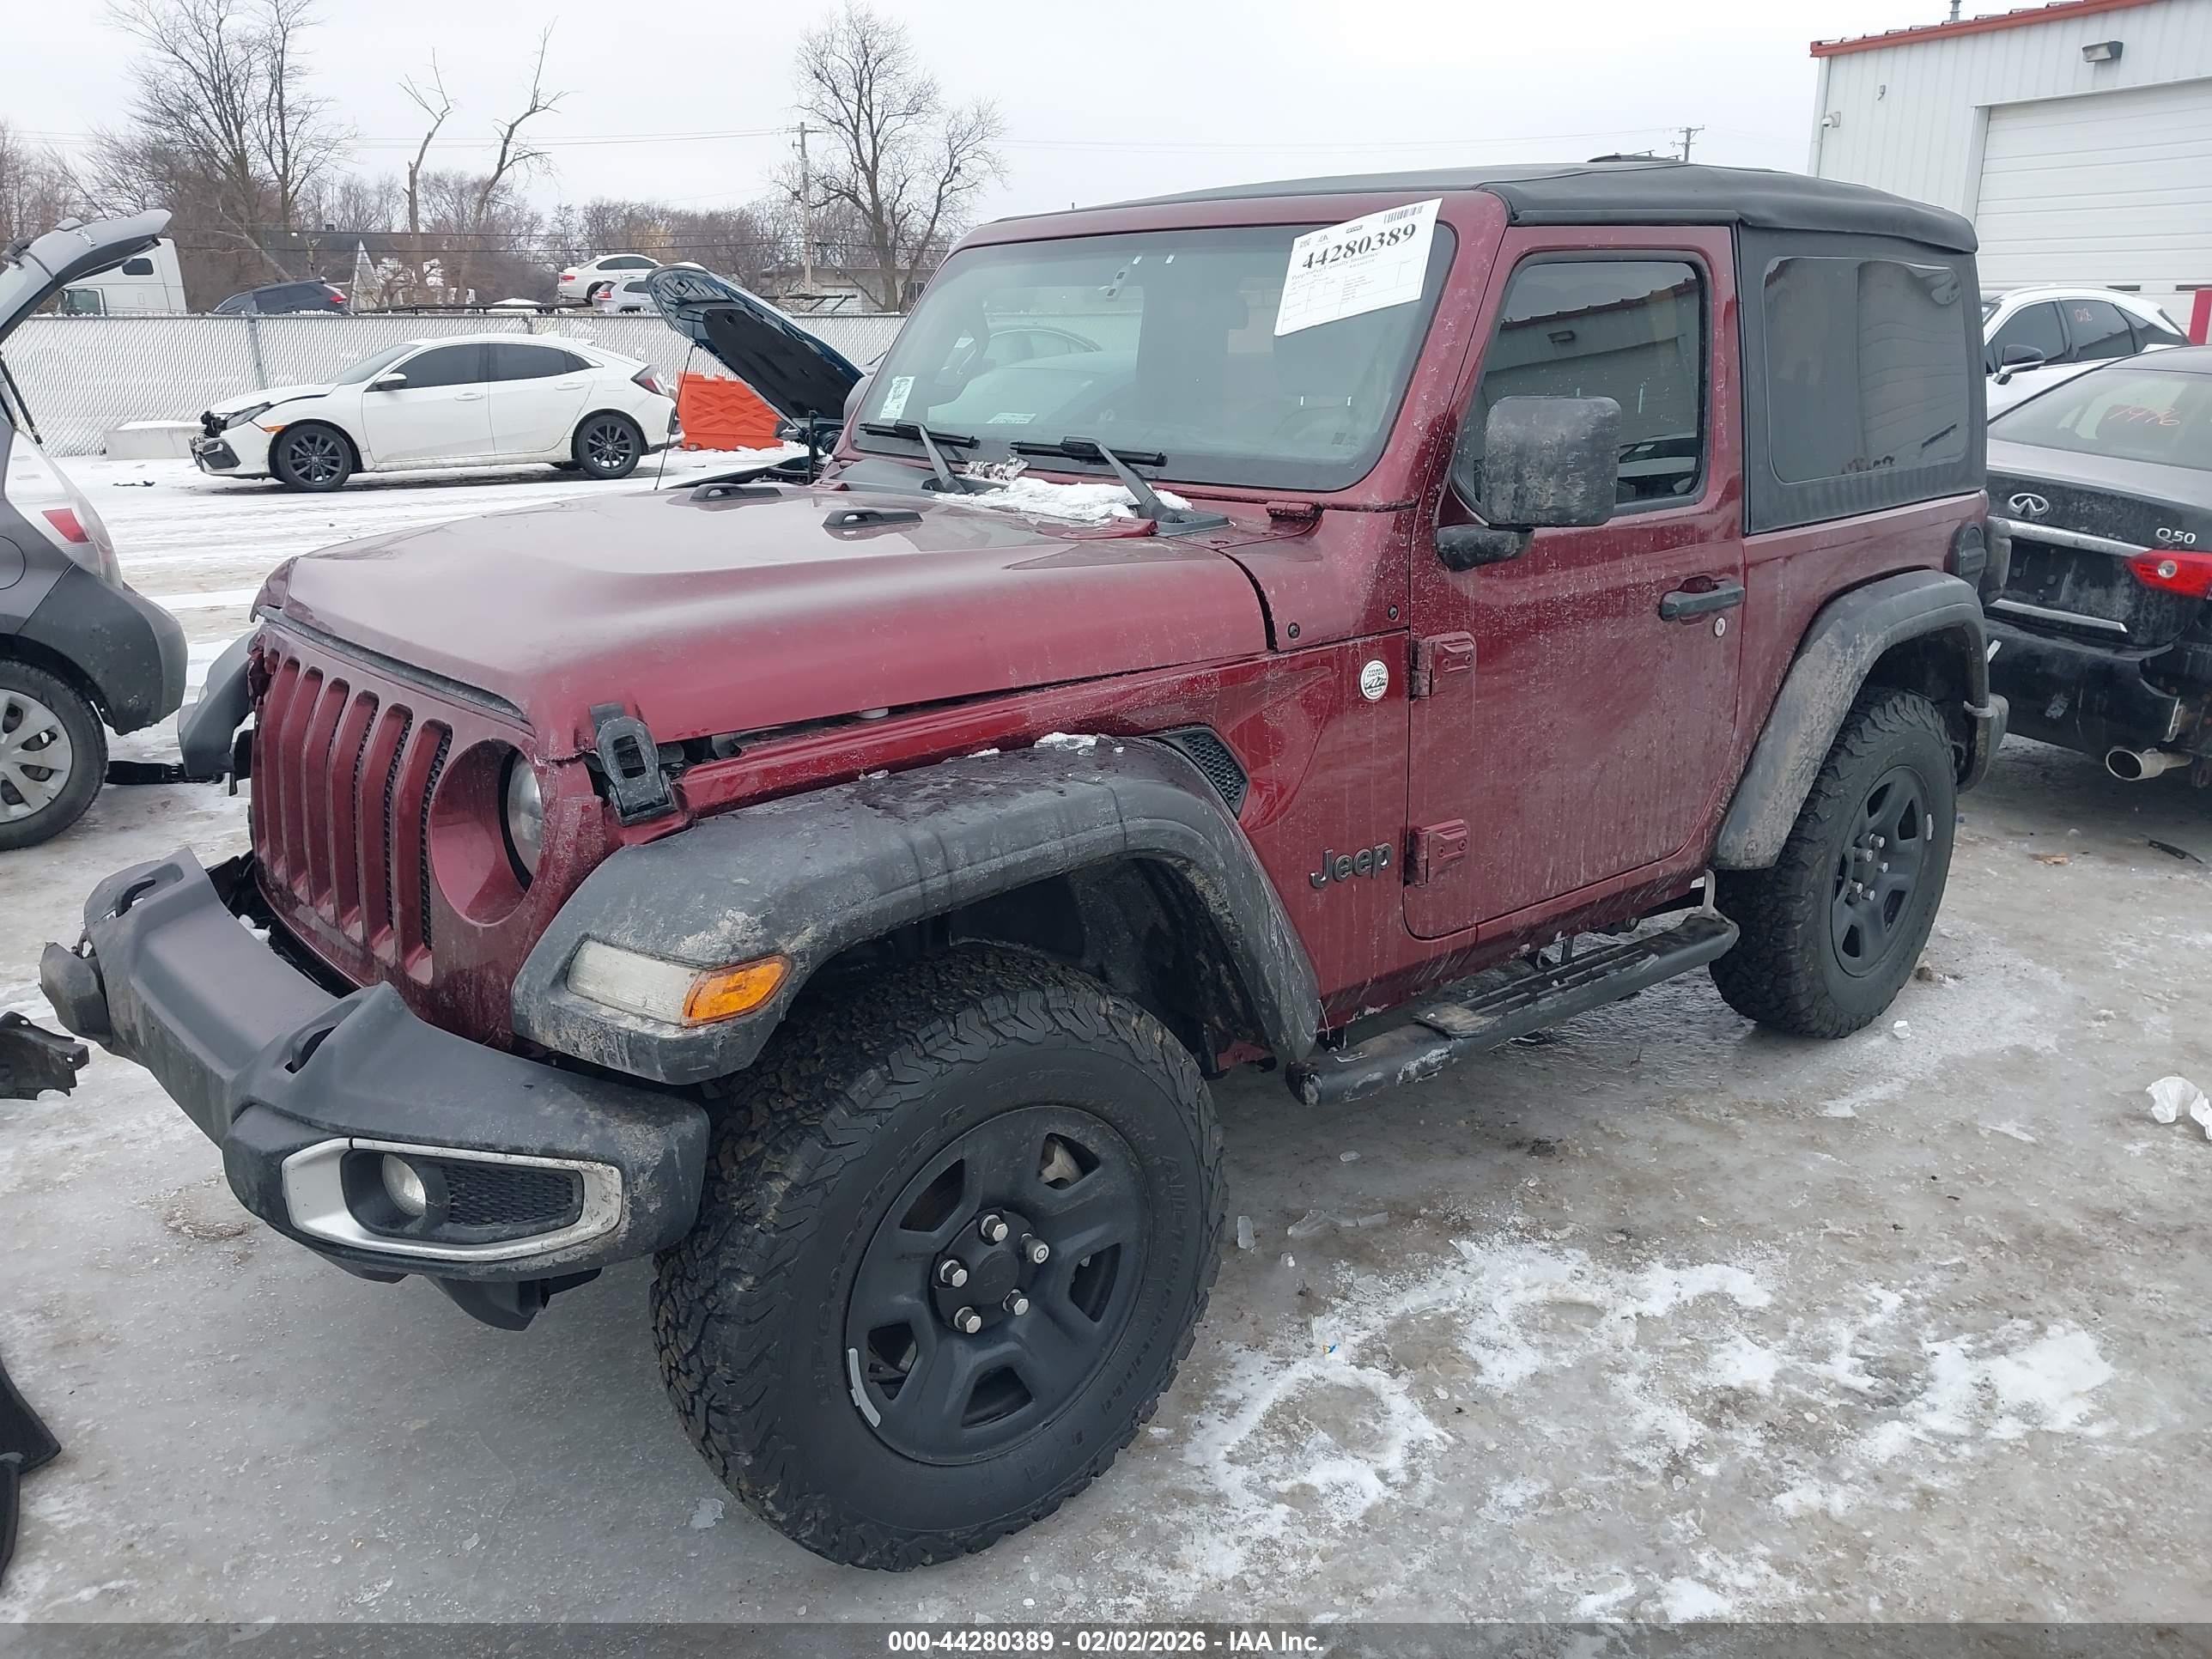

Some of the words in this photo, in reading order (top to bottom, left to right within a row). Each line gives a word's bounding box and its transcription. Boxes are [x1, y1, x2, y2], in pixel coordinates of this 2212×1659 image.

[1302, 223, 1417, 269] 44280389
[2155, 527, 2197, 544] Q50
[1310, 842, 1393, 888] Jeep
